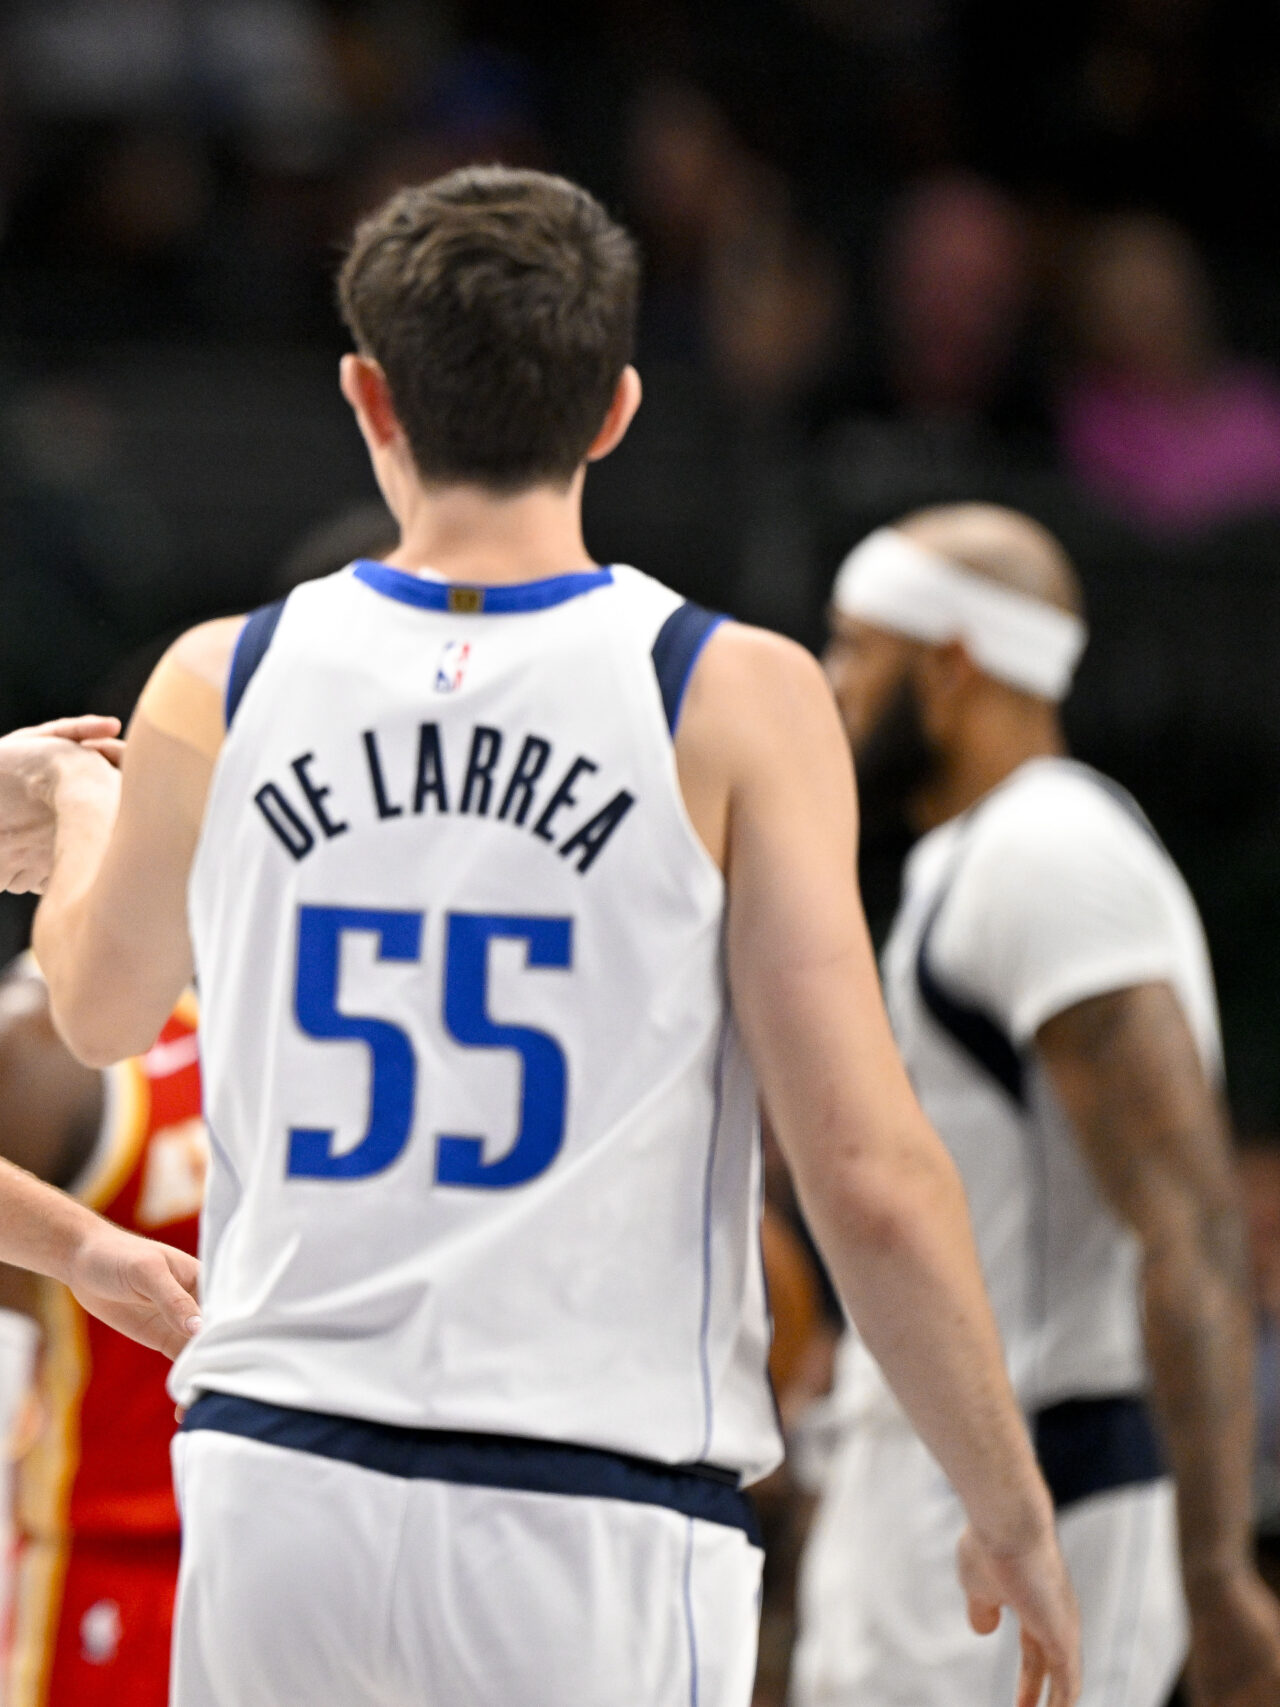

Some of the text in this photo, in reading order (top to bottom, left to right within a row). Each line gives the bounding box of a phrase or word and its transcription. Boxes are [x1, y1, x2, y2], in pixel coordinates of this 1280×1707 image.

[254, 721, 637, 875] DE LARREA
[285, 903, 575, 1190] 55
